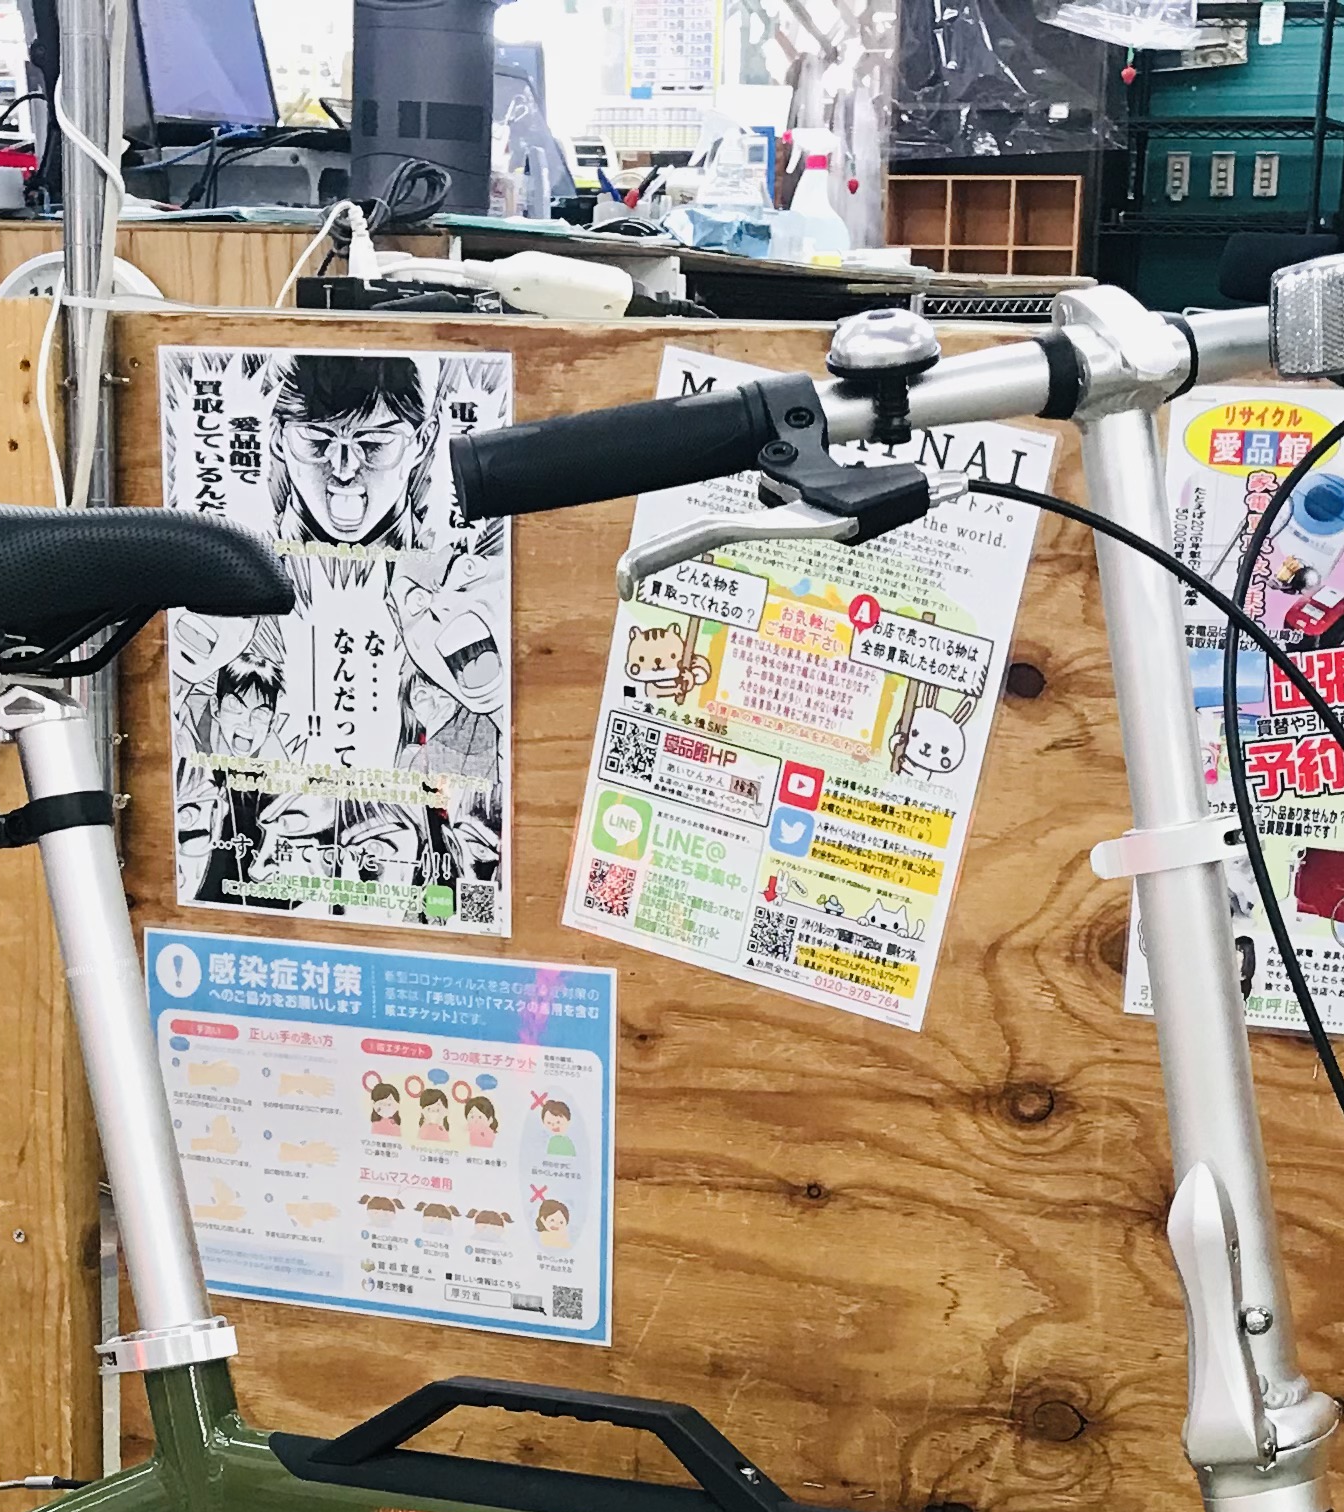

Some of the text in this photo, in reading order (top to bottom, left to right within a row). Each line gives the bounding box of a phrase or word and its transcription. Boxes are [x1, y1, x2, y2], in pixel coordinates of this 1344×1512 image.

[1224, 405, 1304, 428] リサイクル
[1211, 430, 1313, 465] 愛品館
[922, 514, 1007, 550] the world.
[676, 564, 740, 597] どんな物を
[649, 580, 756, 627] 買取ってくれるの？
[781, 605, 837, 633] お気軽に
[764, 620, 845, 654] ご相談下さい
[872, 619, 980, 663] お店で売っている物は
[333, 628, 356, 769] なんだって
[609, 812, 638, 834] LINE
[652, 824, 727, 863] LINE@
[208, 951, 363, 998] 感染症対策
[359, 1167, 454, 1192] 正しいマスクの着用
